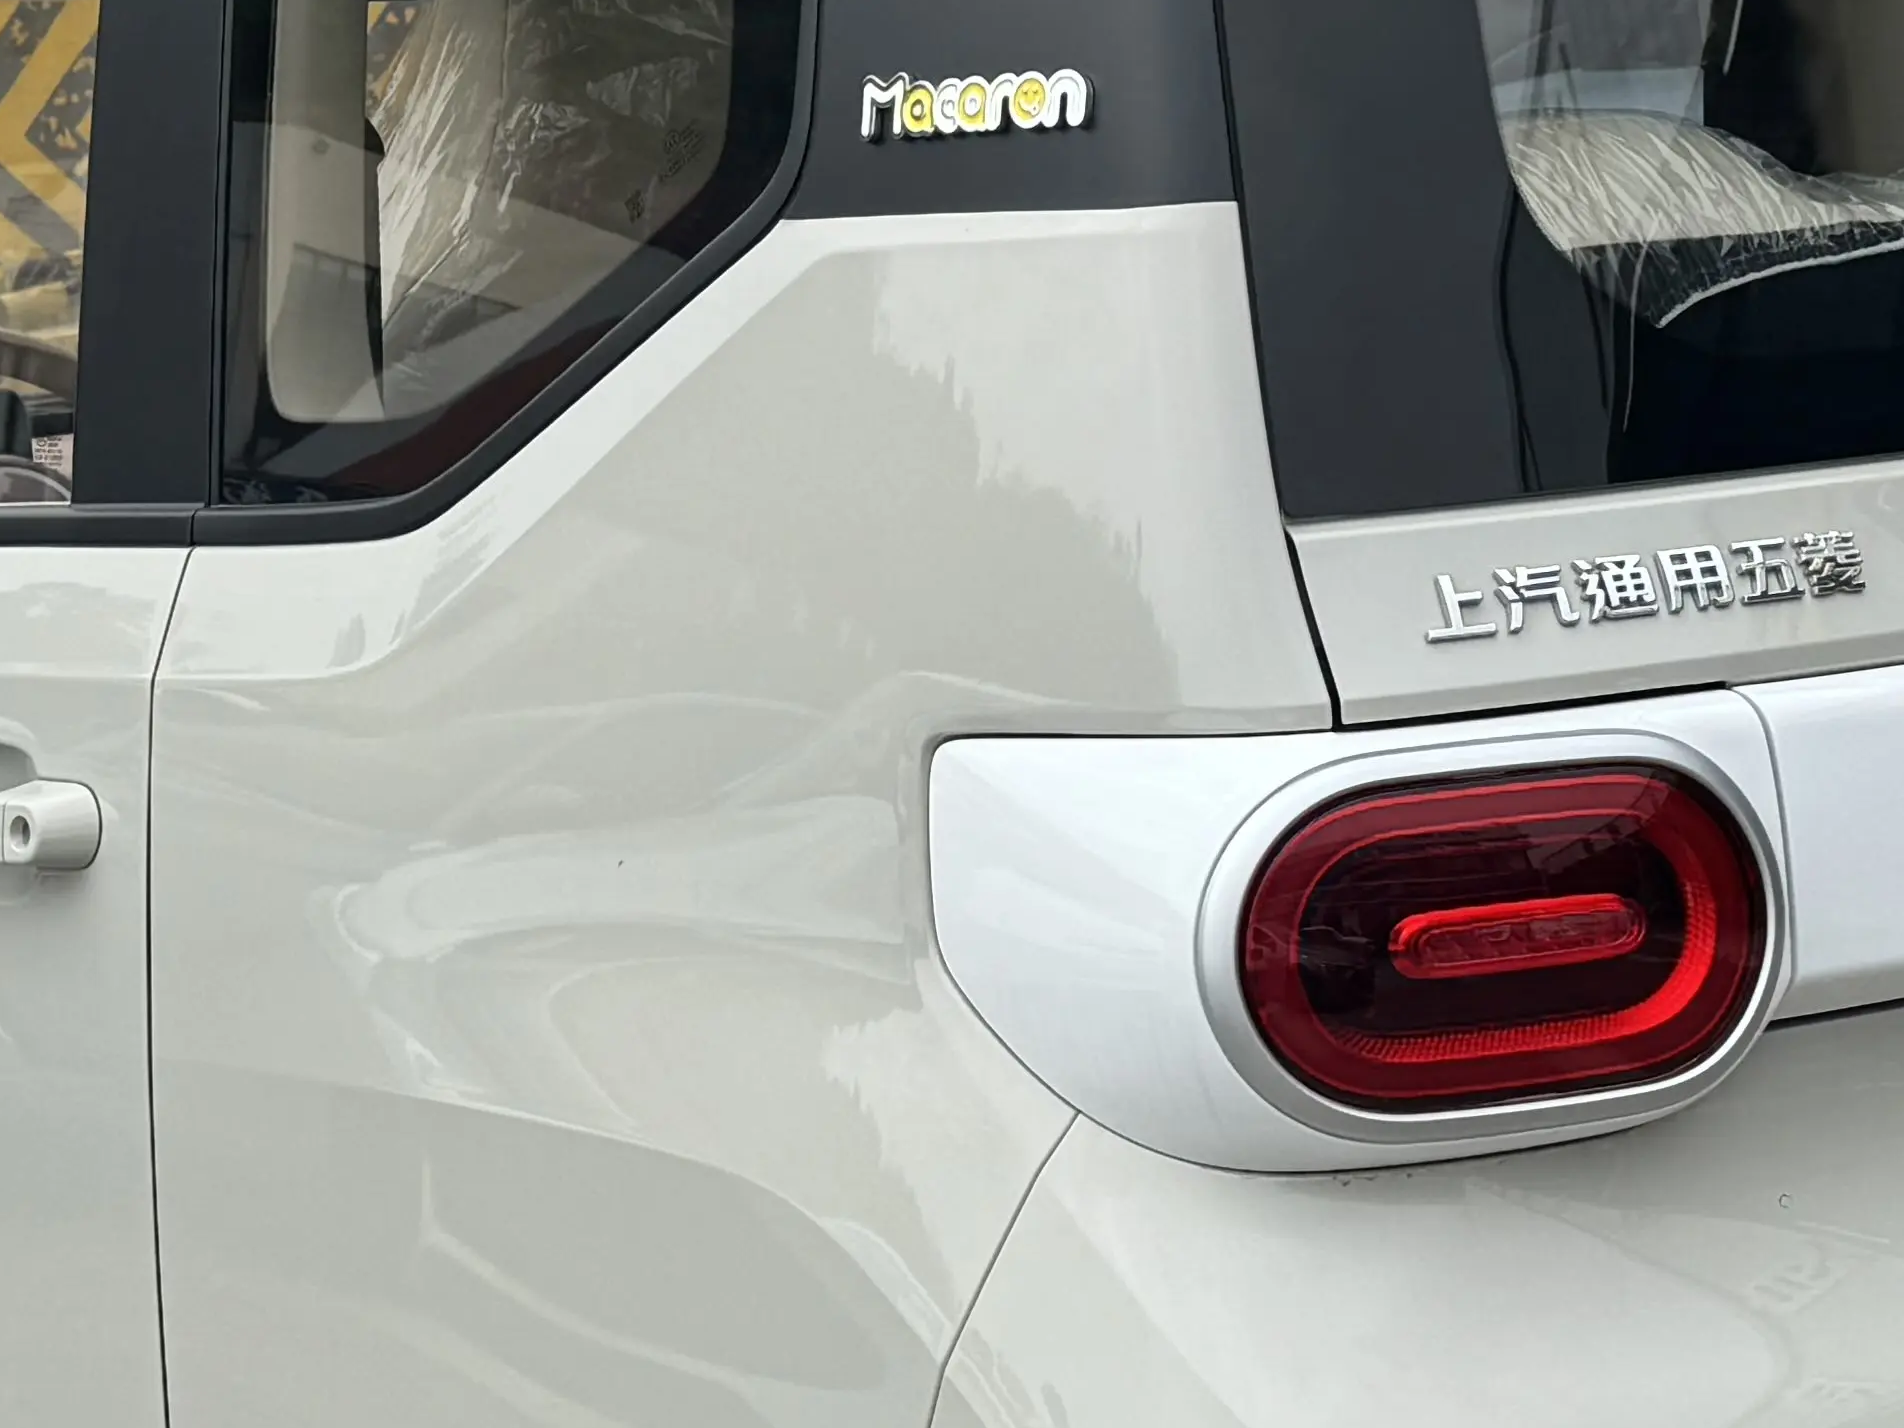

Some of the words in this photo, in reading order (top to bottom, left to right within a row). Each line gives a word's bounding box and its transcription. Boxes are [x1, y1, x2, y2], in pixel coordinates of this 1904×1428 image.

[860, 68, 1093, 142] Macaron
[1424, 529, 1868, 644] 上汽通用五菱
